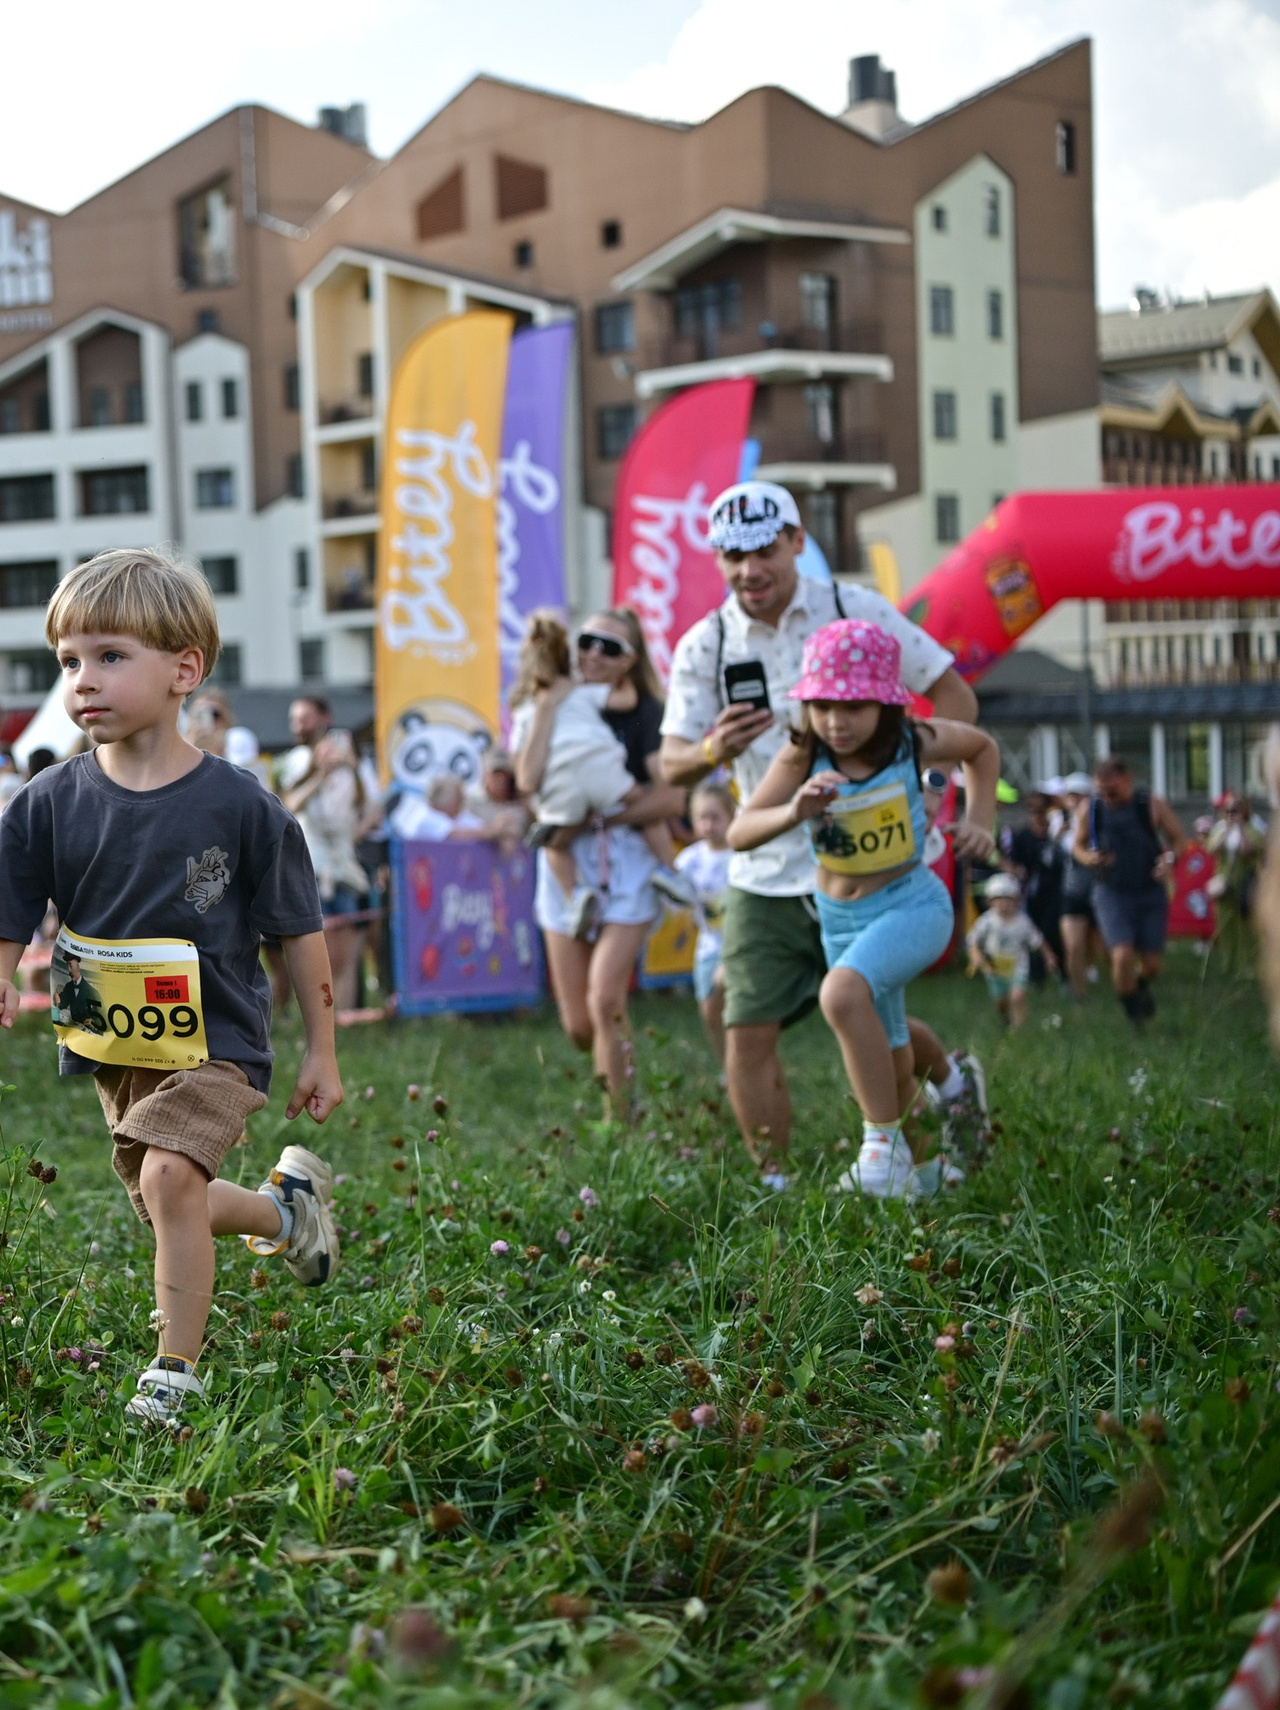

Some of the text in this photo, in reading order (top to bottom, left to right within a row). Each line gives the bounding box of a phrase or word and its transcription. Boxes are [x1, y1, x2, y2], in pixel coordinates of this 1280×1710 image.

[380, 419, 495, 651] Bitey
[842, 821, 907, 857] 5071
[97, 949, 115, 958] ROSA
[116, 950, 133, 958] KIDS
[154, 988, 180, 1000] 16:00
[86, 999, 198, 1041] 5099
